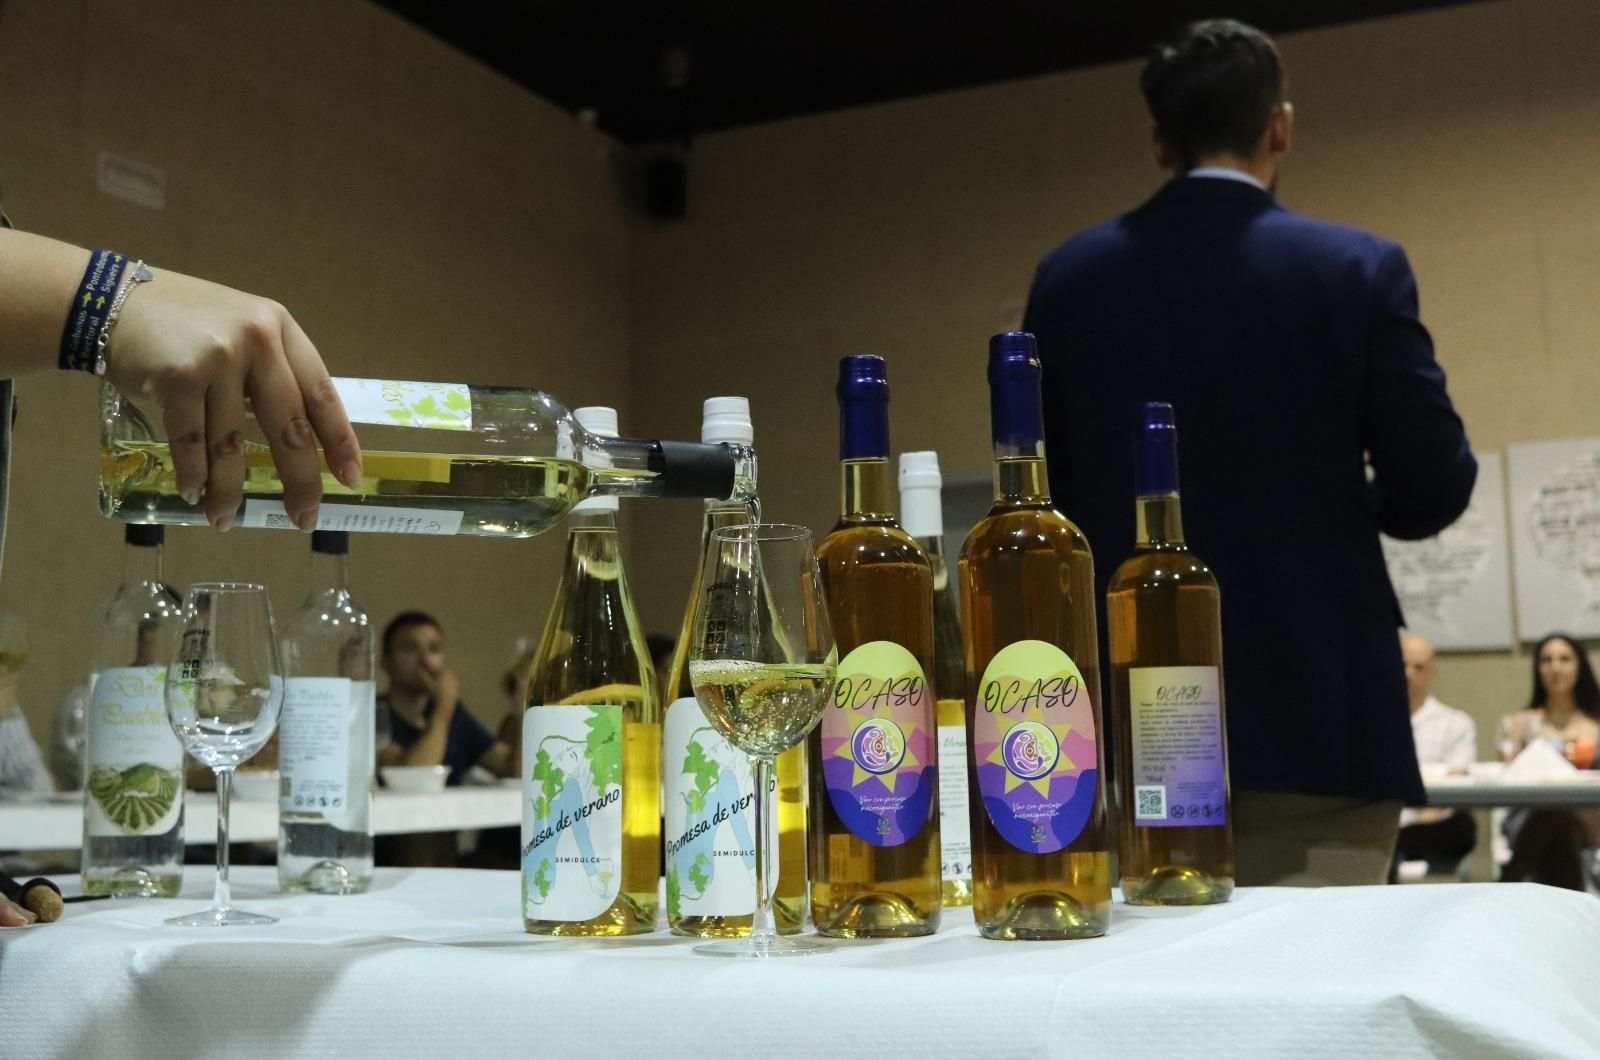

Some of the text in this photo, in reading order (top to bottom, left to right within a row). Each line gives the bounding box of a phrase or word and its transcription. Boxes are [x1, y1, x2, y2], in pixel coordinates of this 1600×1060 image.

[834, 676, 924, 710] OCASO
[984, 675, 1079, 714] OCASO
[1156, 685, 1201, 701] OCASO
[556, 809, 572, 833] de
[574, 788, 620, 822] verano
[666, 780, 775, 857] Promesa de vero
[713, 850, 755, 858] SEMIDULC
